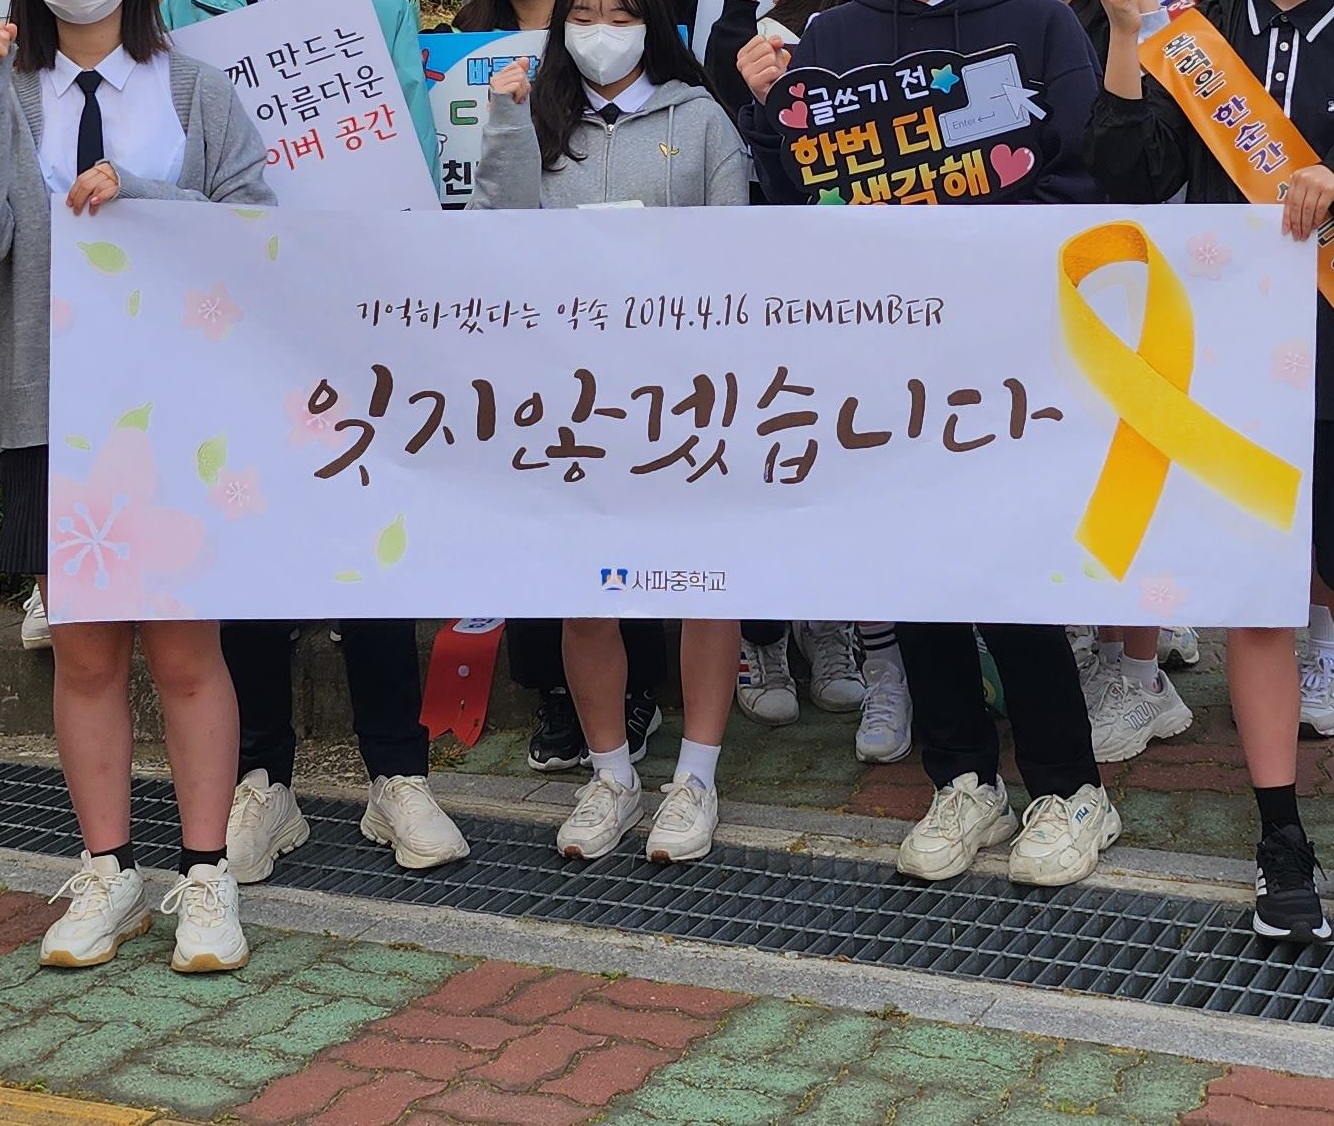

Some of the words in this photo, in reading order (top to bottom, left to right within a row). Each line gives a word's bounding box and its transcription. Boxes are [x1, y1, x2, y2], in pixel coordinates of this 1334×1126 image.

[266, 28, 365, 80] 만드는
[256, 65, 385, 126] 아름다운
[807, 80, 889, 126] 글쓰기
[896, 65, 930, 101] 전
[335, 103, 398, 151] 공간
[791, 120, 885, 186] 한번
[892, 106, 943, 156] 더
[357, 297, 541, 334] 기억하겠다는
[557, 297, 609, 331] 약속
[624, 293, 750, 330] 2014.4.16
[765, 295, 946, 327] REMEMBER
[631, 570, 727, 592] 사파중학교
